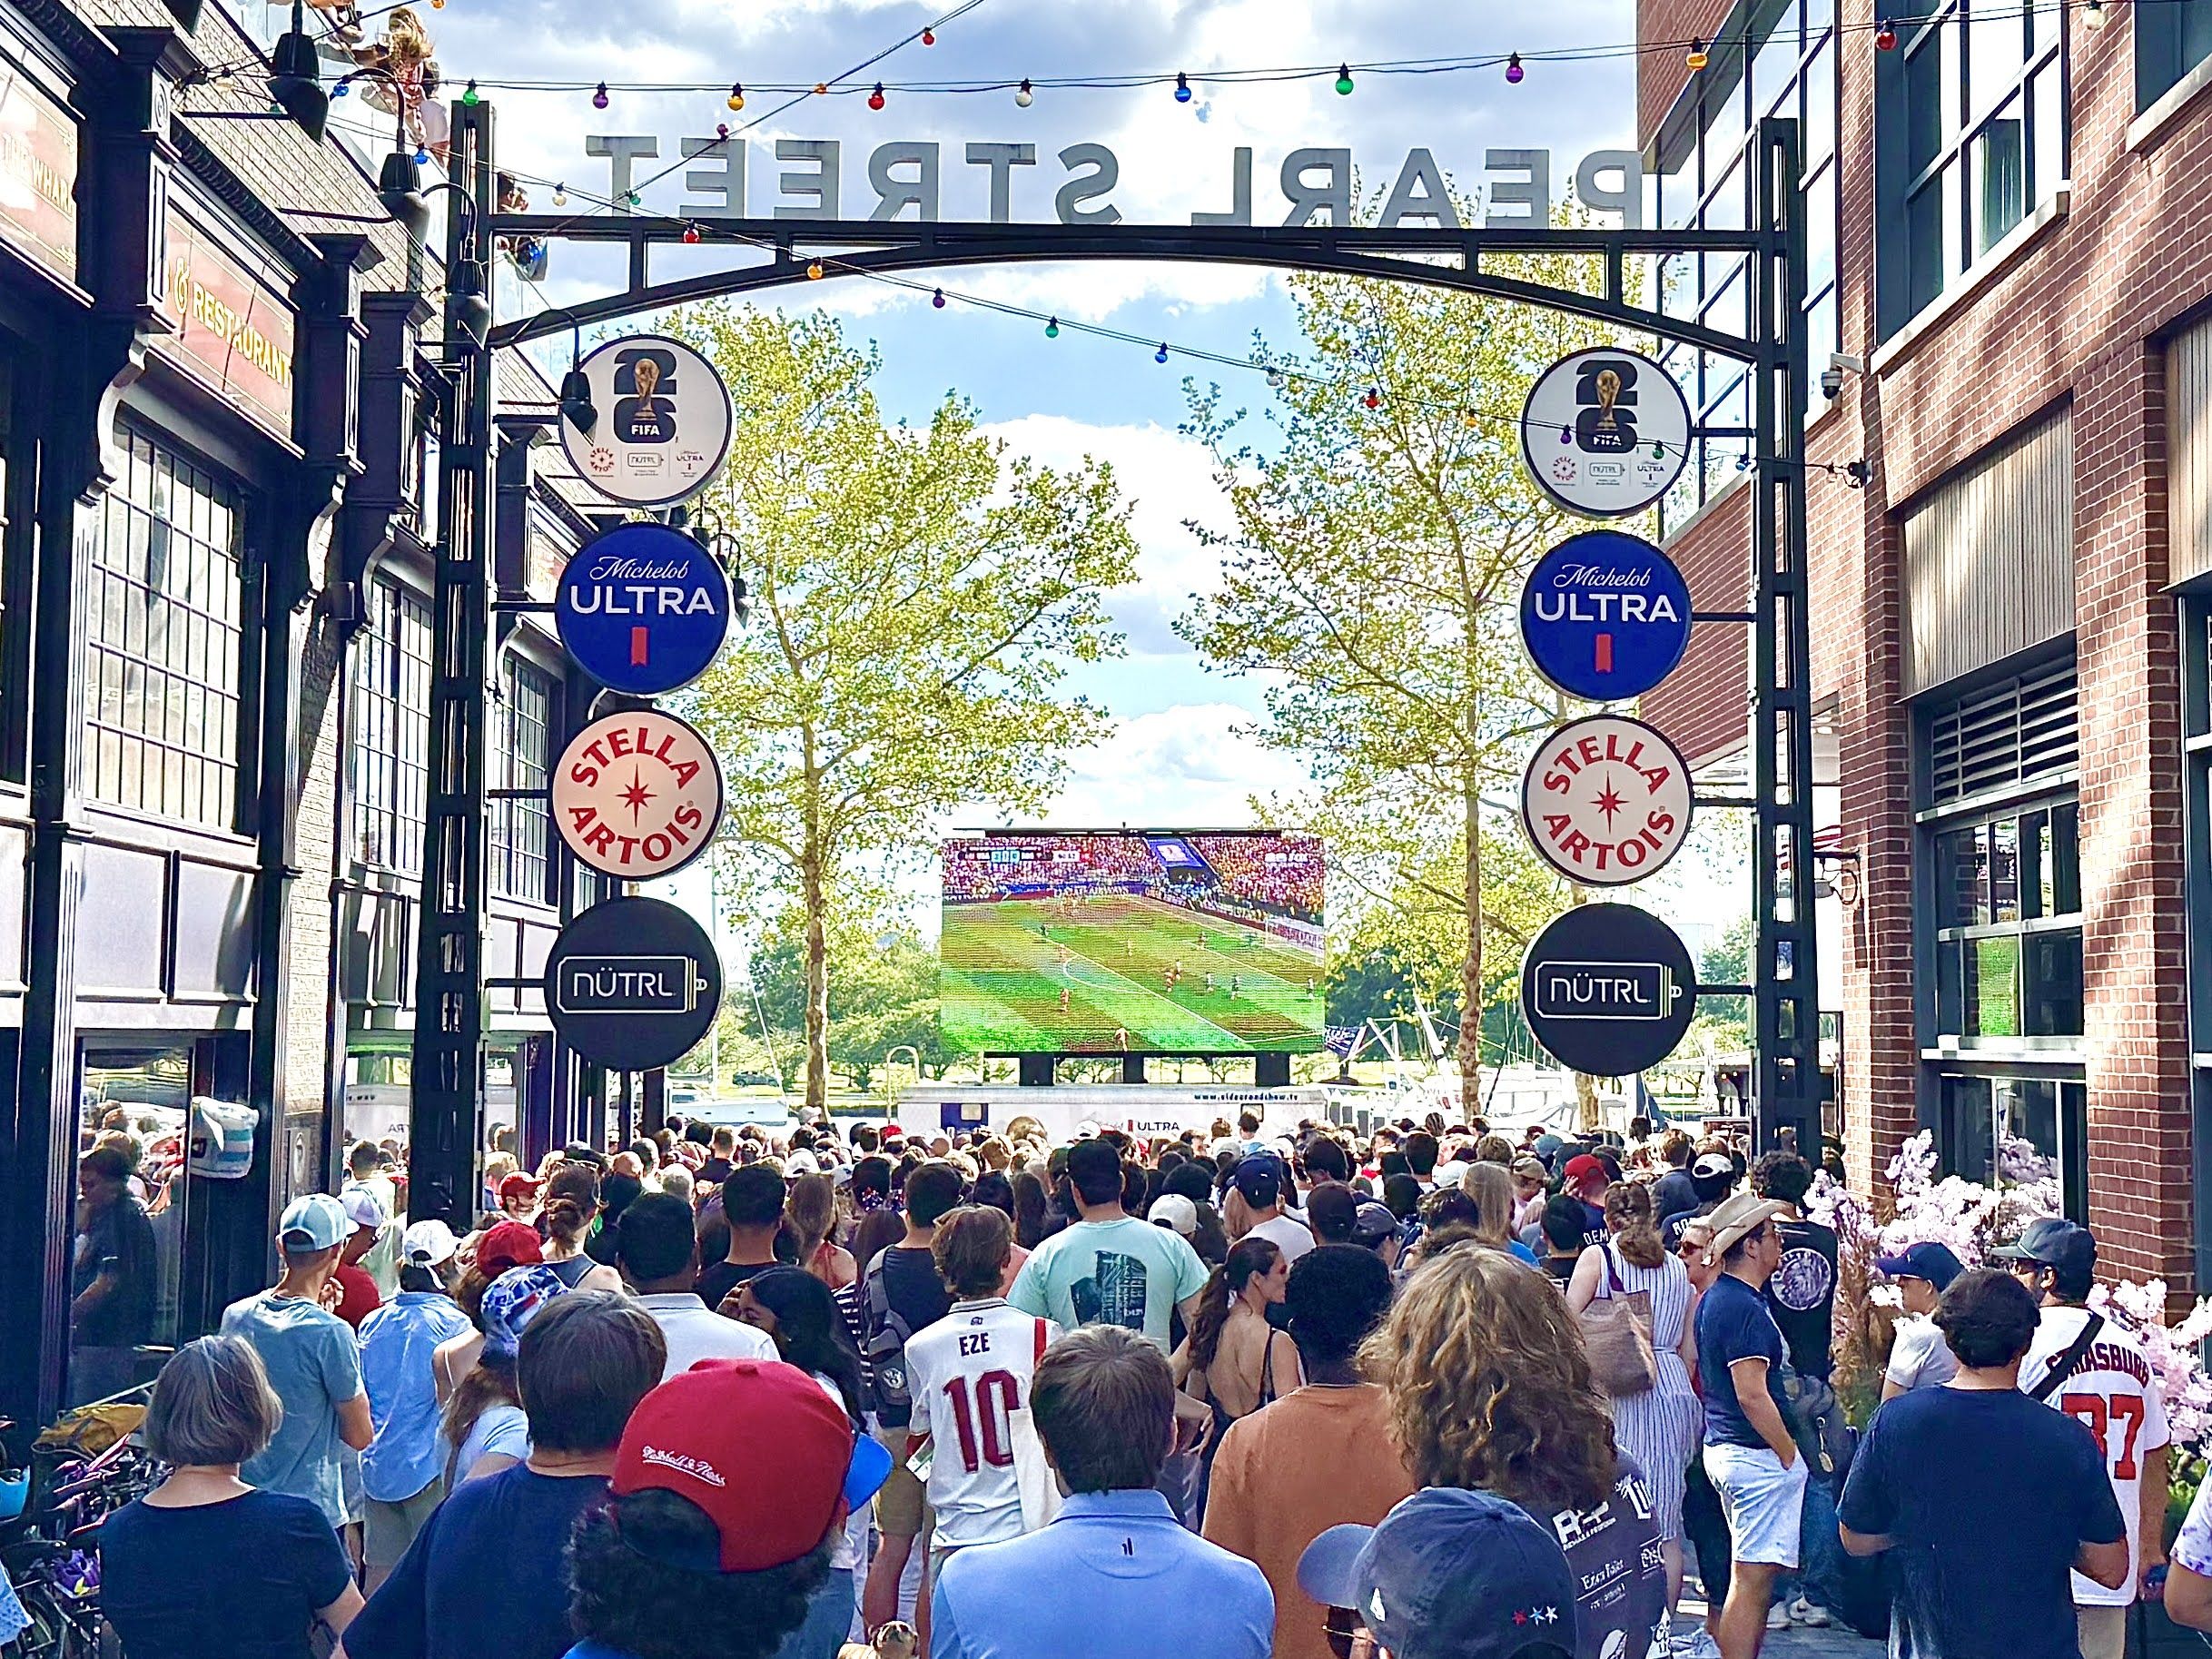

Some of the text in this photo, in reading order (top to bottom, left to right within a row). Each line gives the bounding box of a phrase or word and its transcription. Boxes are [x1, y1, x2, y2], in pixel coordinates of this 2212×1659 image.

[193, 281, 292, 389] RESTAURANT
[631, 424, 660, 436] FIFA
[1593, 434, 1622, 446] FIFA
[590, 556, 689, 579] Michelob
[1554, 564, 1652, 588] Michelob
[570, 585, 716, 615] ULTRA
[1535, 592, 1677, 622] ULTRA
[571, 727, 700, 789] STELLA
[1544, 734, 1670, 795] STELLA
[568, 805, 703, 864] ARTOIS
[1543, 810, 1674, 870] ARTOIS
[1138, 1121, 1180, 1131] ULTRA
[959, 1332, 991, 1358] EZE
[2045, 1342, 2149, 1388] SRASBURG
[943, 1369, 1022, 1474] 10
